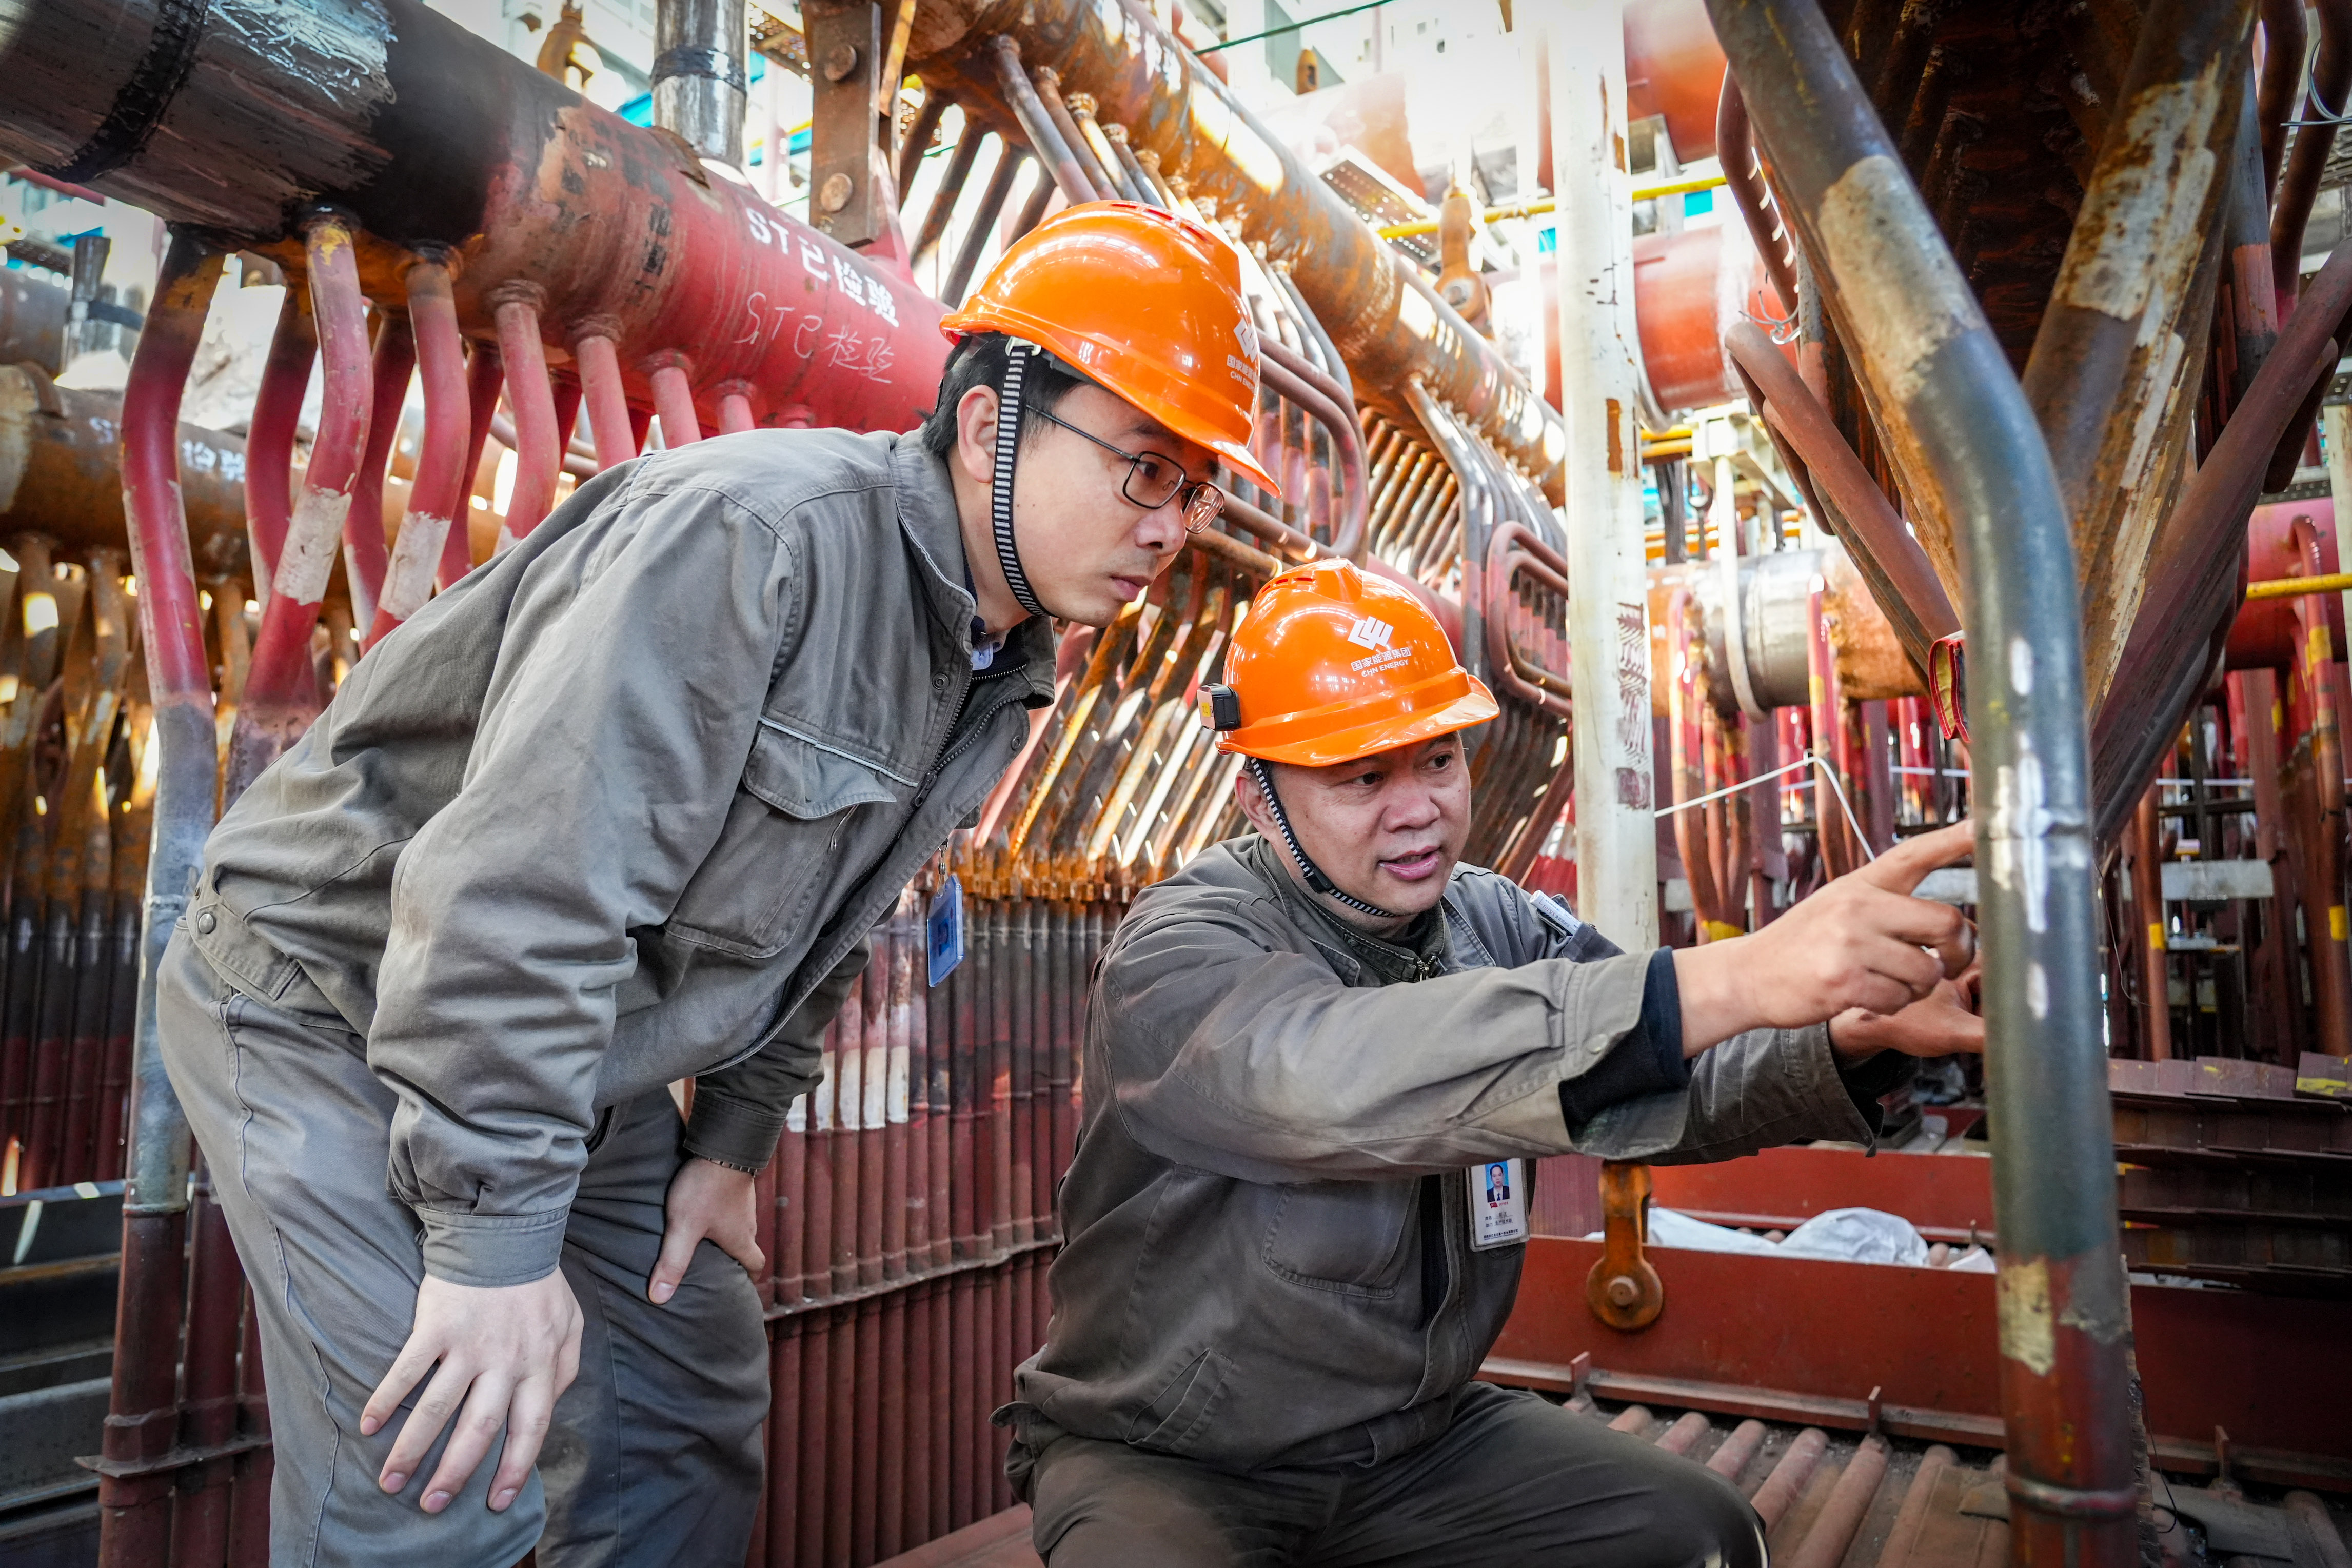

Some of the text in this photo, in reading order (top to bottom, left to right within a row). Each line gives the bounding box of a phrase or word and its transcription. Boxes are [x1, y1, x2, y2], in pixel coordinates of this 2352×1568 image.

[1351, 647, 1412, 672] 国家能源集团
[1361, 659, 1409, 677] CHN ENERGY
